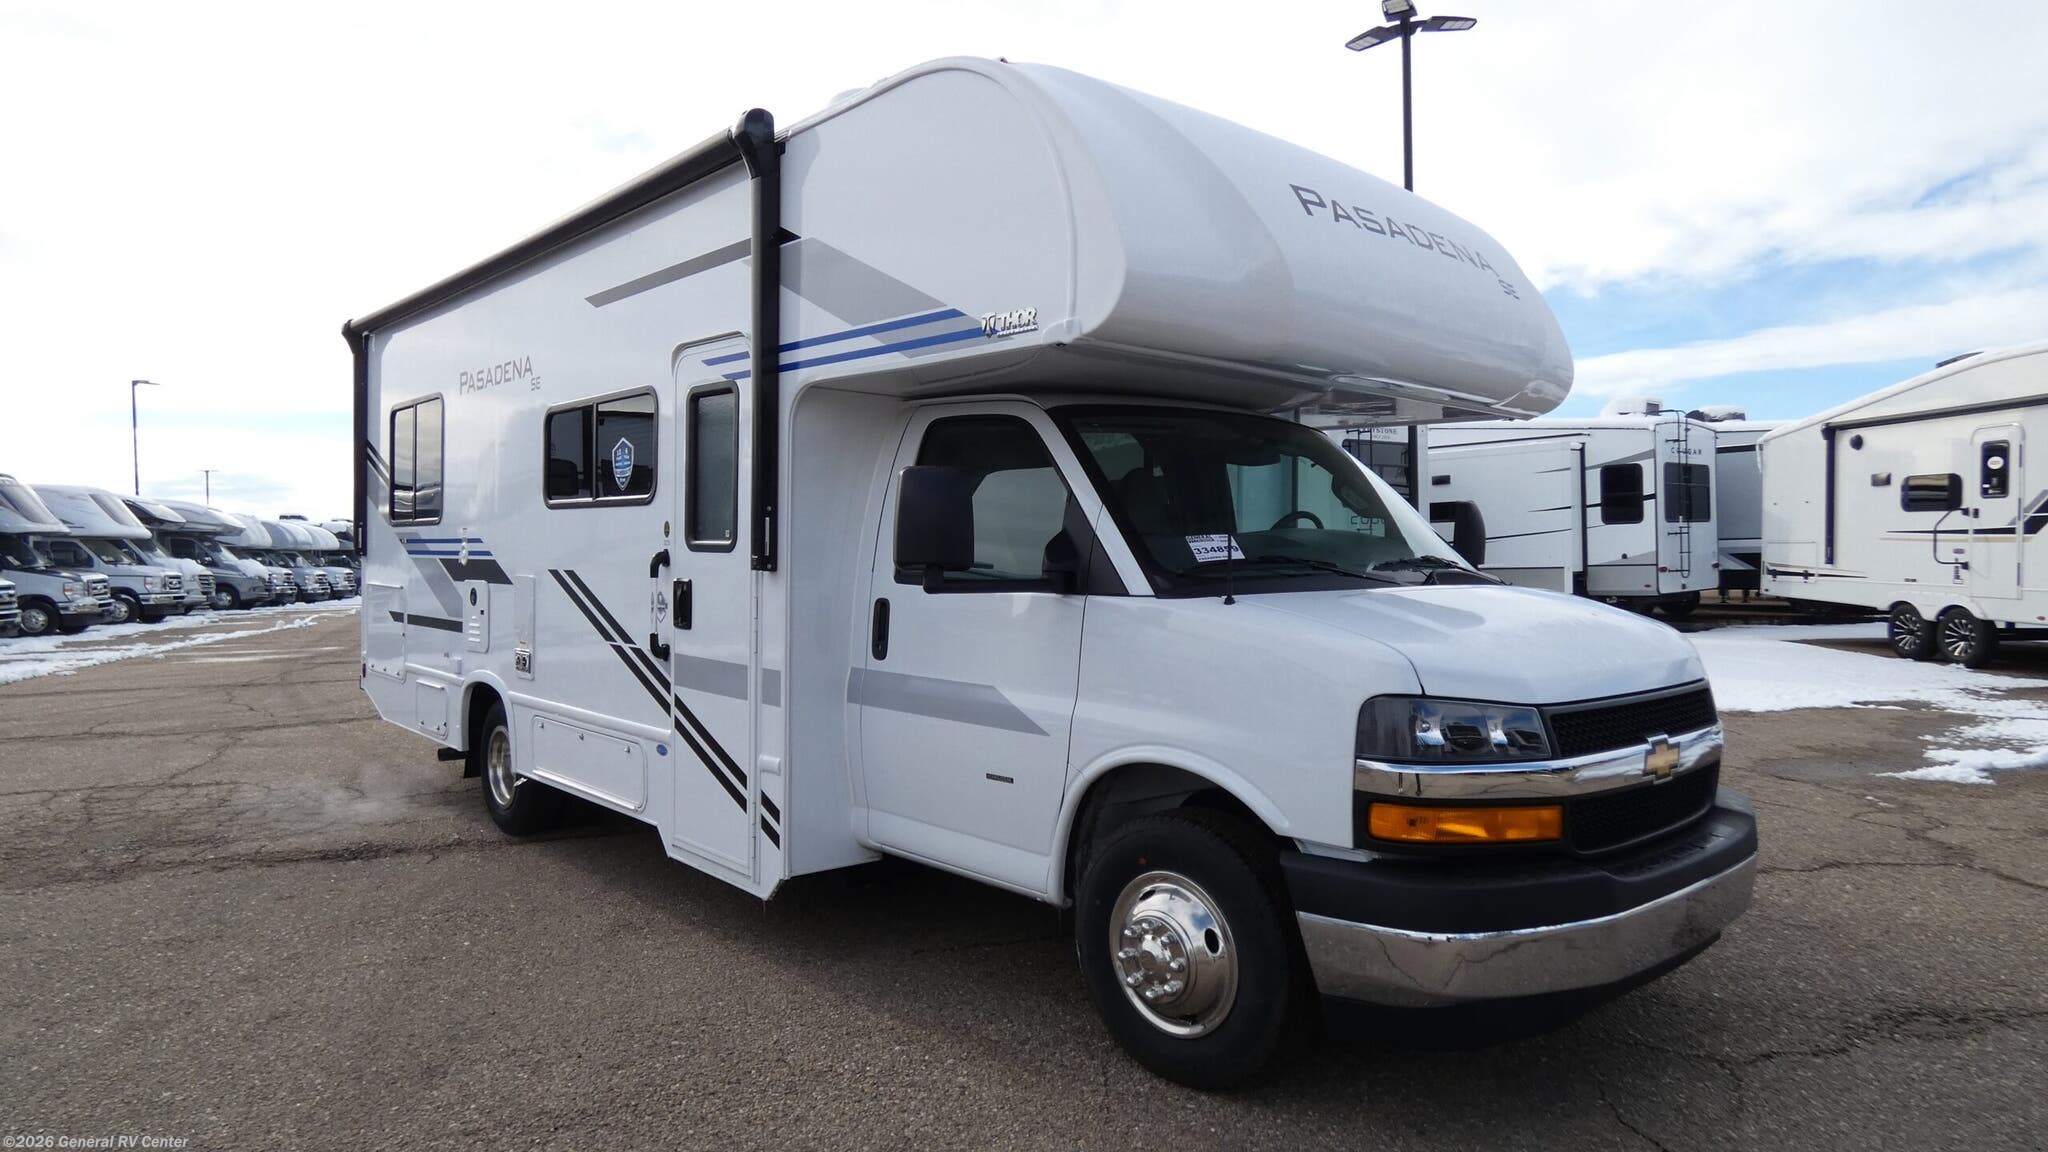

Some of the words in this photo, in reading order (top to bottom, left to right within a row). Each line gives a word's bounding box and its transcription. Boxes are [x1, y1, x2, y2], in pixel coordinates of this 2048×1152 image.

[1289, 183, 1501, 278] PASADENA
[996, 307, 1039, 332] THOR
[459, 355, 534, 396] PASADENA
[530, 376, 541, 391] SE
